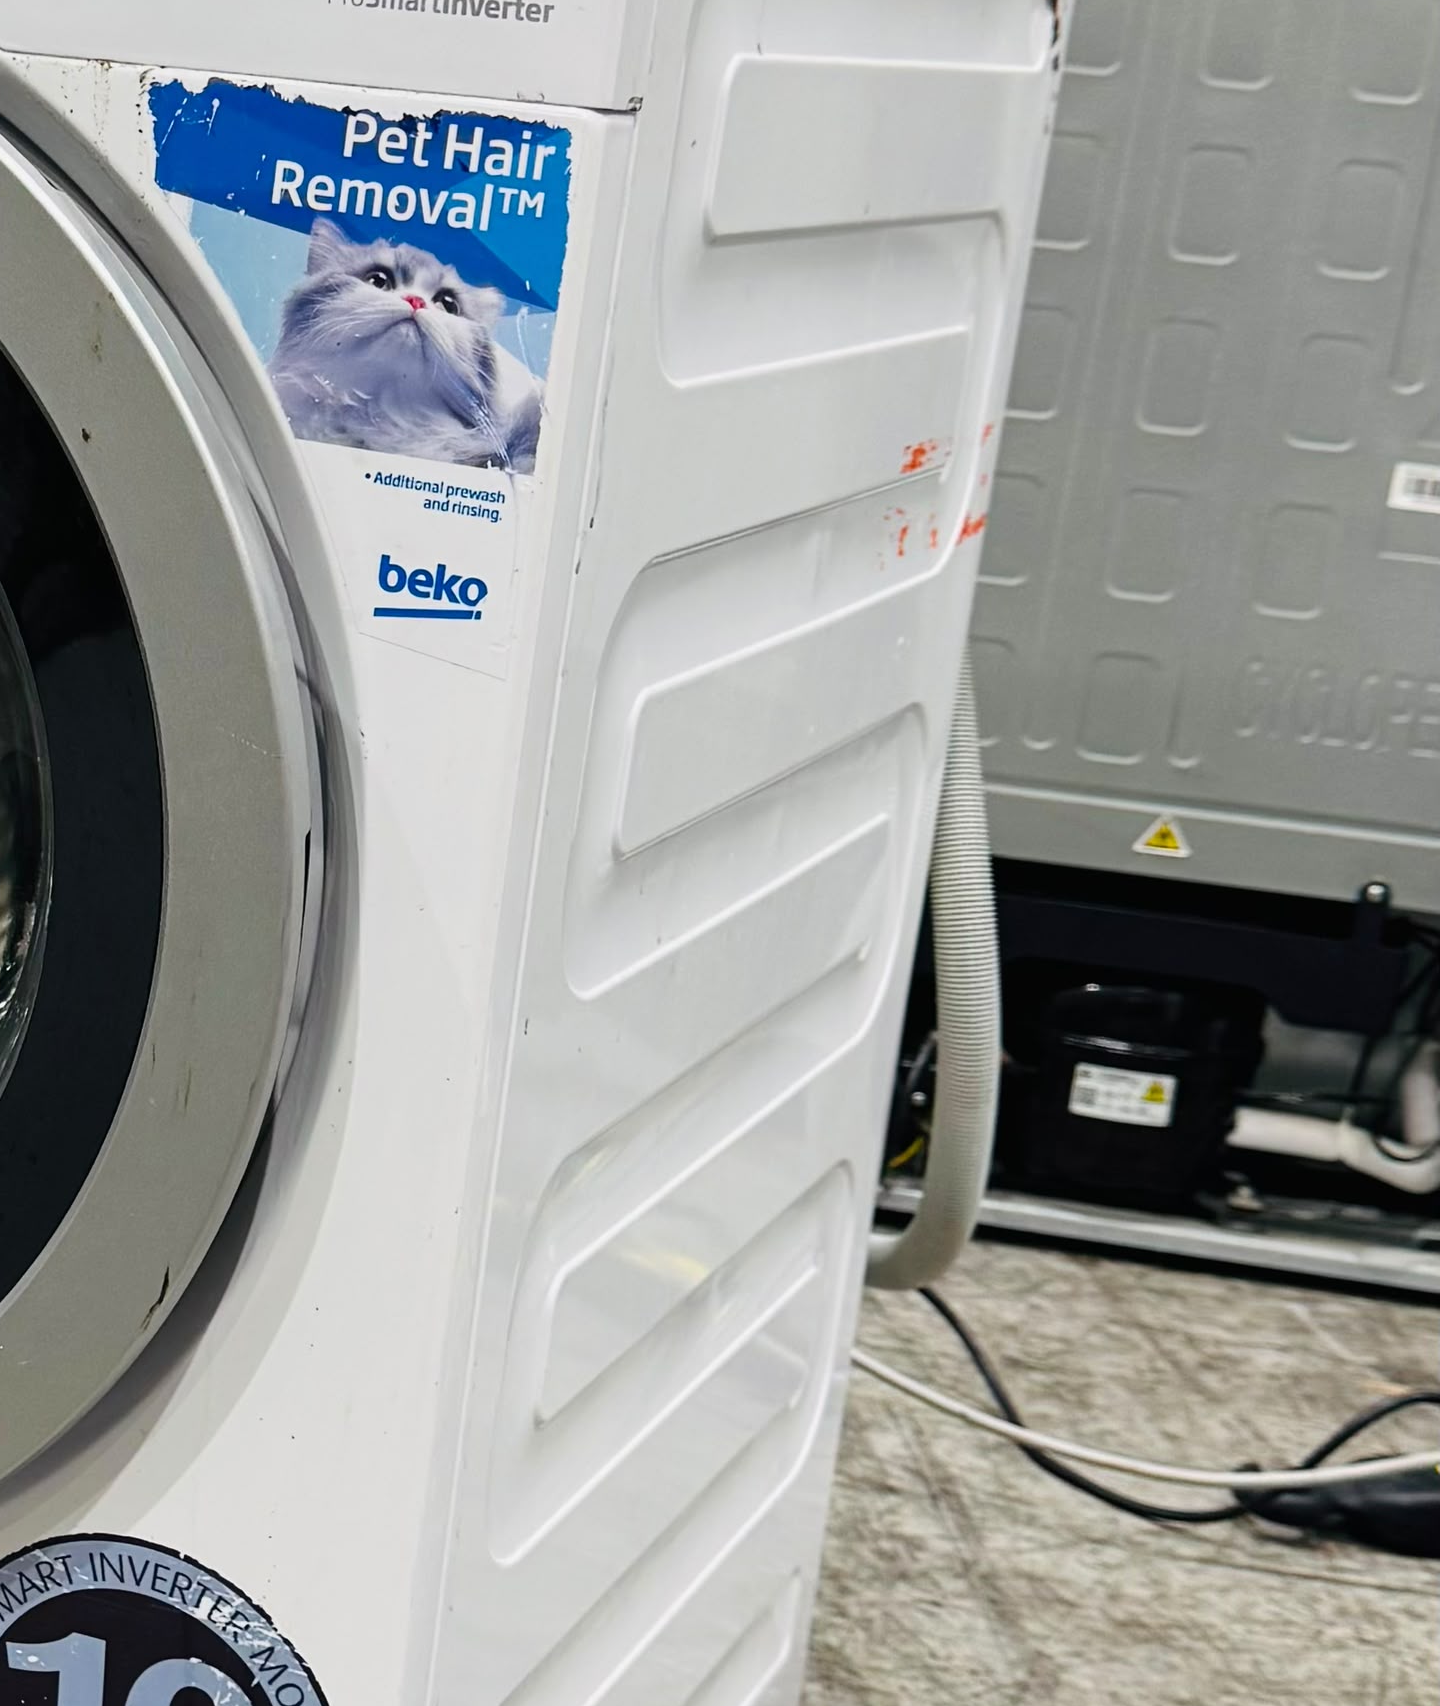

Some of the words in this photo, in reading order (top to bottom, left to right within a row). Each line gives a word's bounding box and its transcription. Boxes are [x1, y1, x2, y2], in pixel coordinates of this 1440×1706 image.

[343, 111, 441, 168] Pet
[443, 122, 556, 181] Hair
[373, 471, 445, 494] Additional
[445, 485, 506, 505] prewash
[423, 497, 450, 512] and
[451, 501, 503, 524] rinsing.
[377, 553, 489, 608] beko
[88, 1550, 252, 1645] INVERTER
